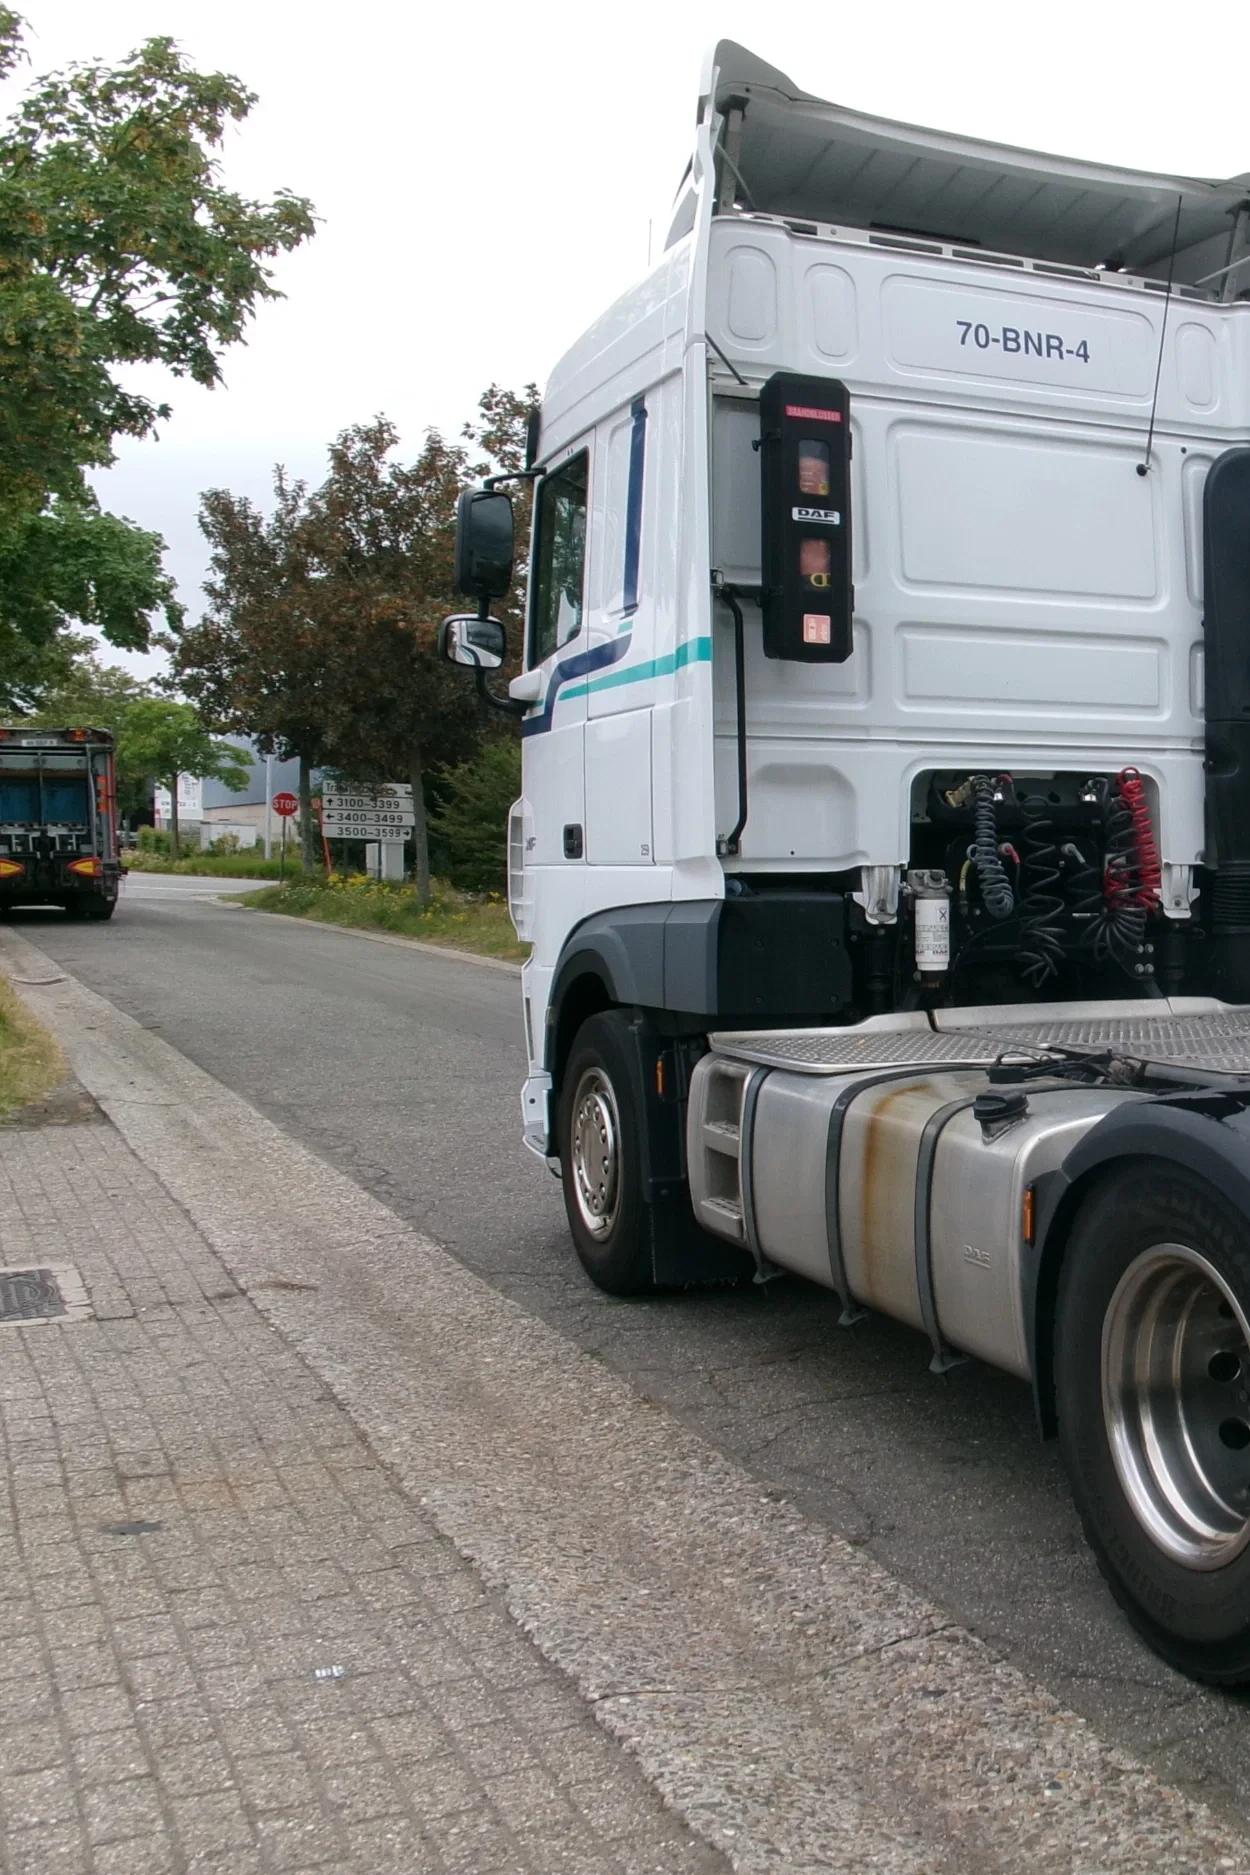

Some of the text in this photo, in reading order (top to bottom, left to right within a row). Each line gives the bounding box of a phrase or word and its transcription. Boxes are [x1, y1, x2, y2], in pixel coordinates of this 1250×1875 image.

[956, 320, 1090, 364] 70-BNR-4
[797, 508, 835, 519] DAF
[272, 798, 297, 810] STOP
[336, 797, 400, 810] 3100-3399
[336, 812, 403, 824] 3400-3499
[336, 826, 401, 838] 3500-3599
